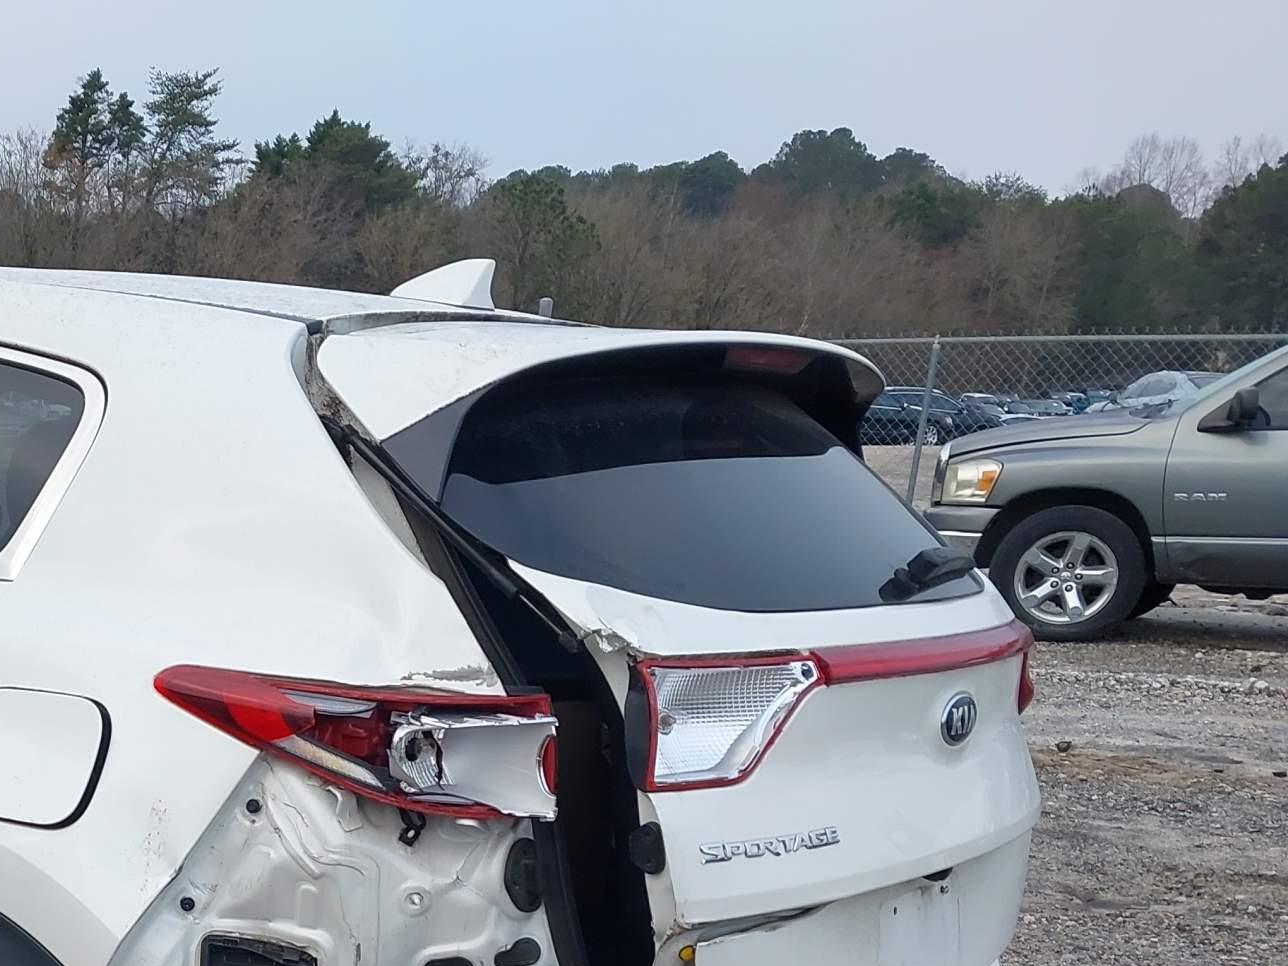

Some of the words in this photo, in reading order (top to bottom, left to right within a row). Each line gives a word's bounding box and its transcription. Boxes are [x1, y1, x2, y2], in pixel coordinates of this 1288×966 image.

[1173, 492, 1227, 502] RAM
[951, 704, 976, 735] KIA
[699, 826, 840, 864] SPORTAGE
